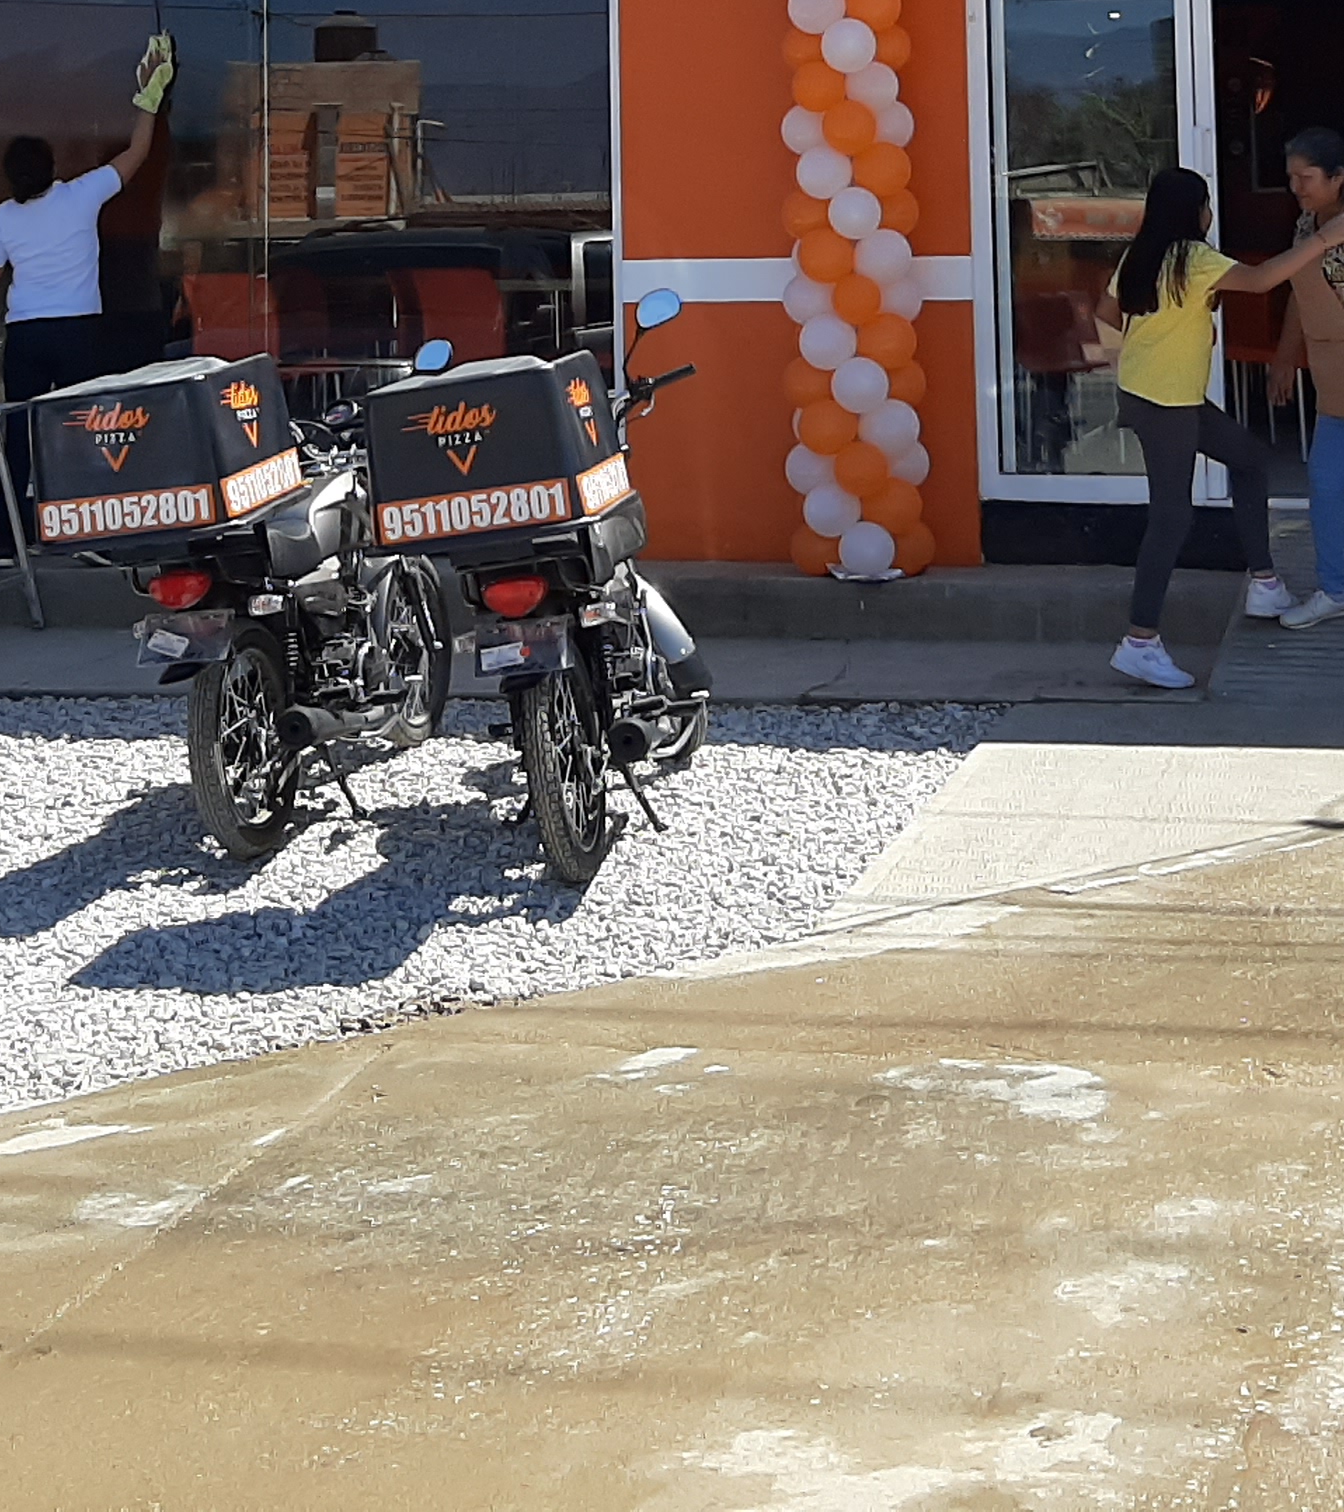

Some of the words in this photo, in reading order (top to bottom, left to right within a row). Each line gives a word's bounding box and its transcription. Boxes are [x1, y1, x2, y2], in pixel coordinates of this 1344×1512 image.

[84, 401, 151, 432] lidos
[427, 400, 497, 435] lidos
[95, 431, 137, 445] PIZZA
[438, 431, 484, 448] PIZZA
[42, 488, 211, 538] 9511052801
[382, 482, 566, 540] 9511052801
